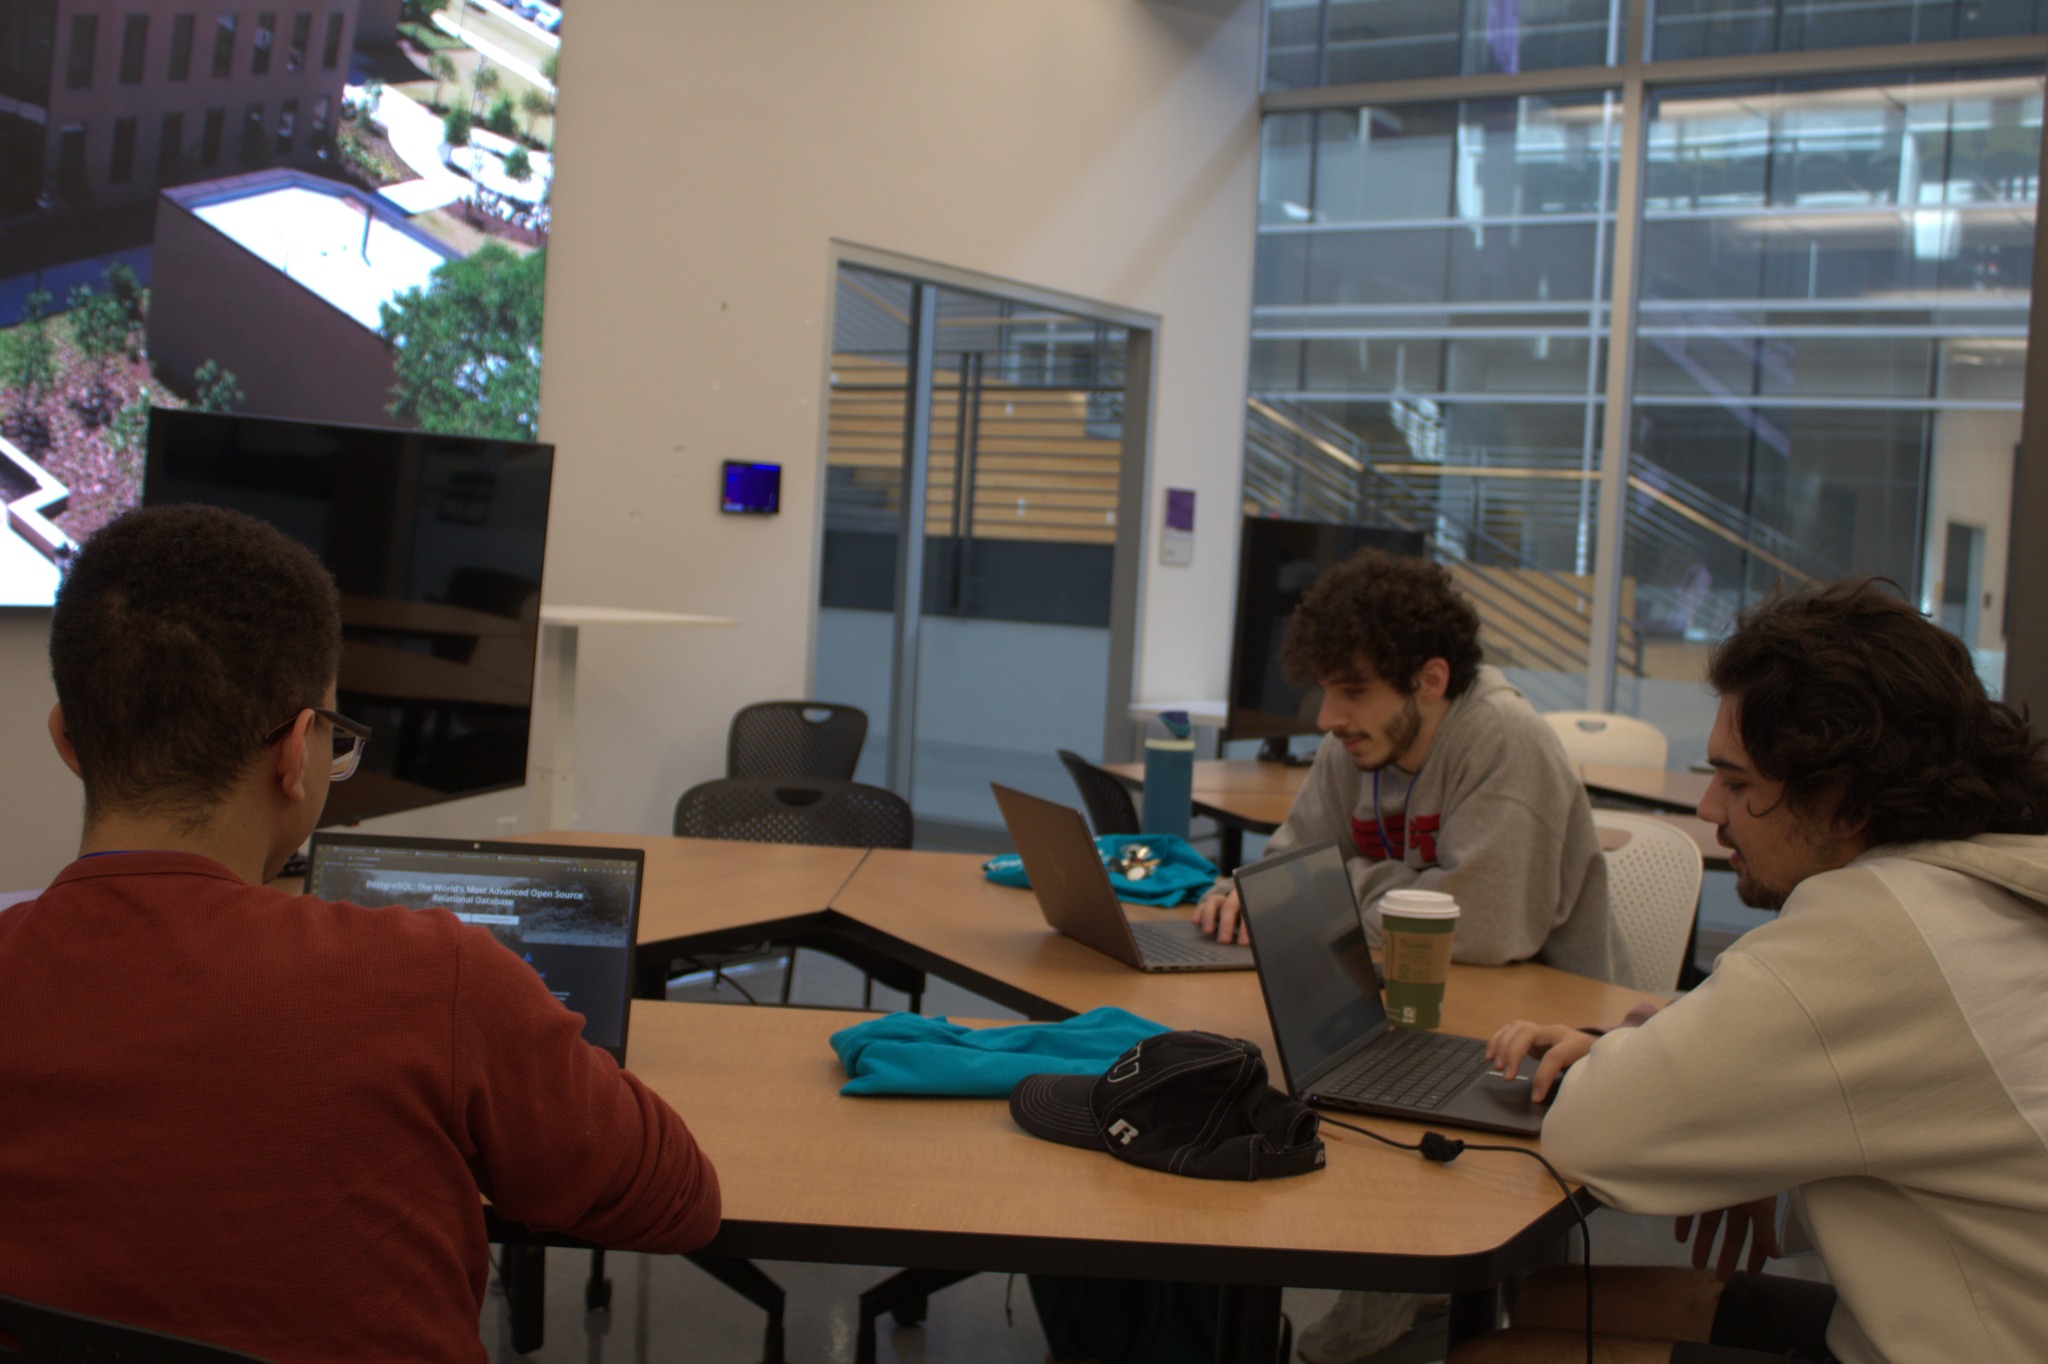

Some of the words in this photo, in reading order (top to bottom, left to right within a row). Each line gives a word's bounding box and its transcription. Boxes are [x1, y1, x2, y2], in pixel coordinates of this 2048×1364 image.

[366, 879, 415, 891] PostgreSQL:
[418, 882, 432, 891] The
[434, 883, 464, 893] World's
[466, 885, 487, 894] Most
[488, 887, 529, 897] Advanced
[530, 889, 553, 899] Open
[554, 890, 584, 900] Source
[432, 893, 474, 904] Relational
[475, 896, 514, 906] Database
